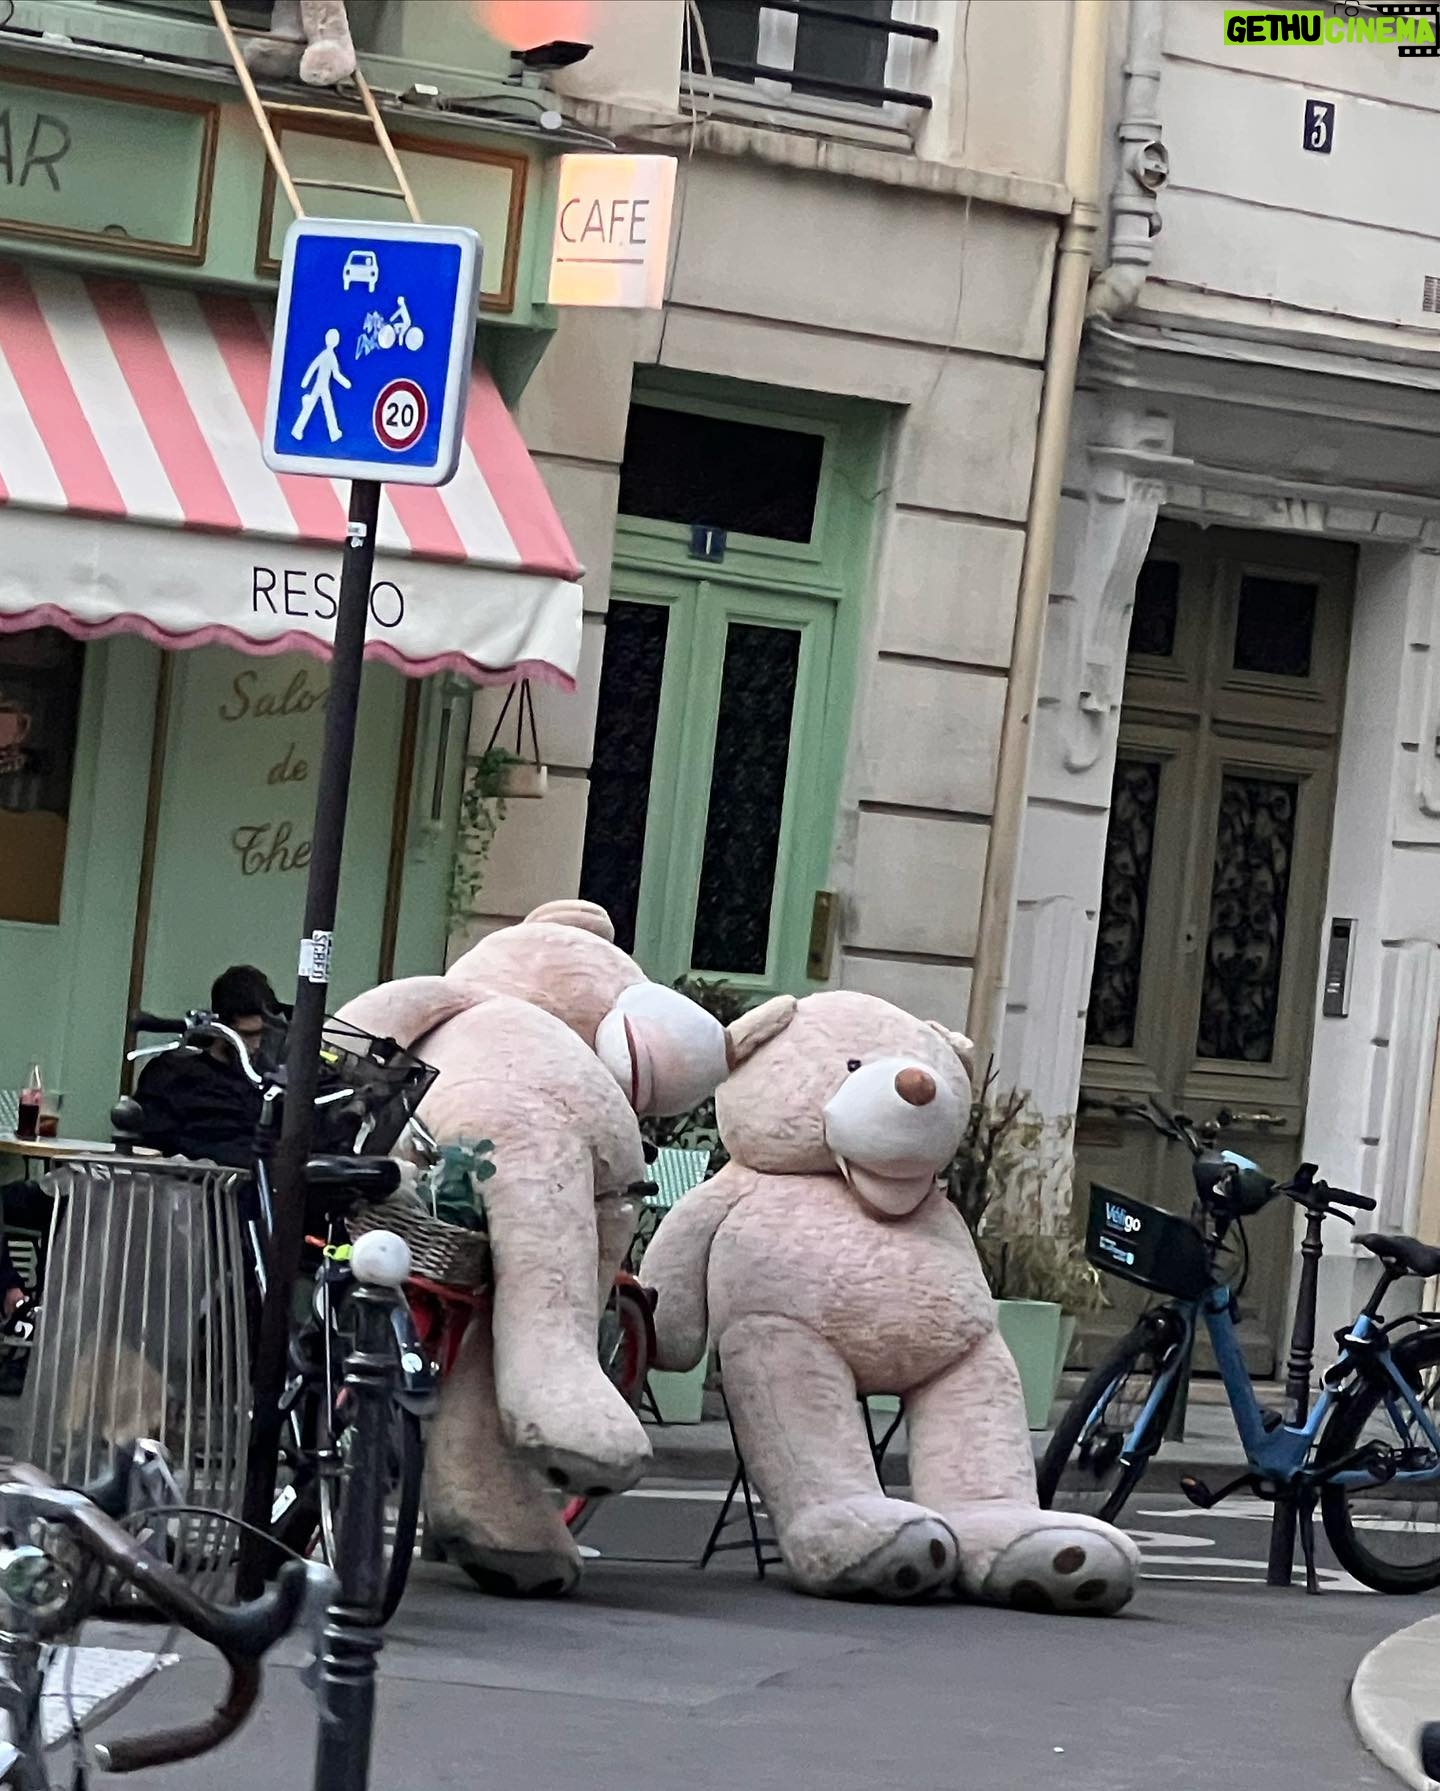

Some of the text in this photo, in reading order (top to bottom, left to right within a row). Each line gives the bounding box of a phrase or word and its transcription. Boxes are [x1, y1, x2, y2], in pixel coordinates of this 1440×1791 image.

[1311, 105, 1327, 148] 3
[560, 198, 650, 244] CAFE
[386, 402, 414, 427] 20
[253, 566, 404, 628] RESO
[219, 670, 329, 721] Salo
[267, 742, 308, 785] de
